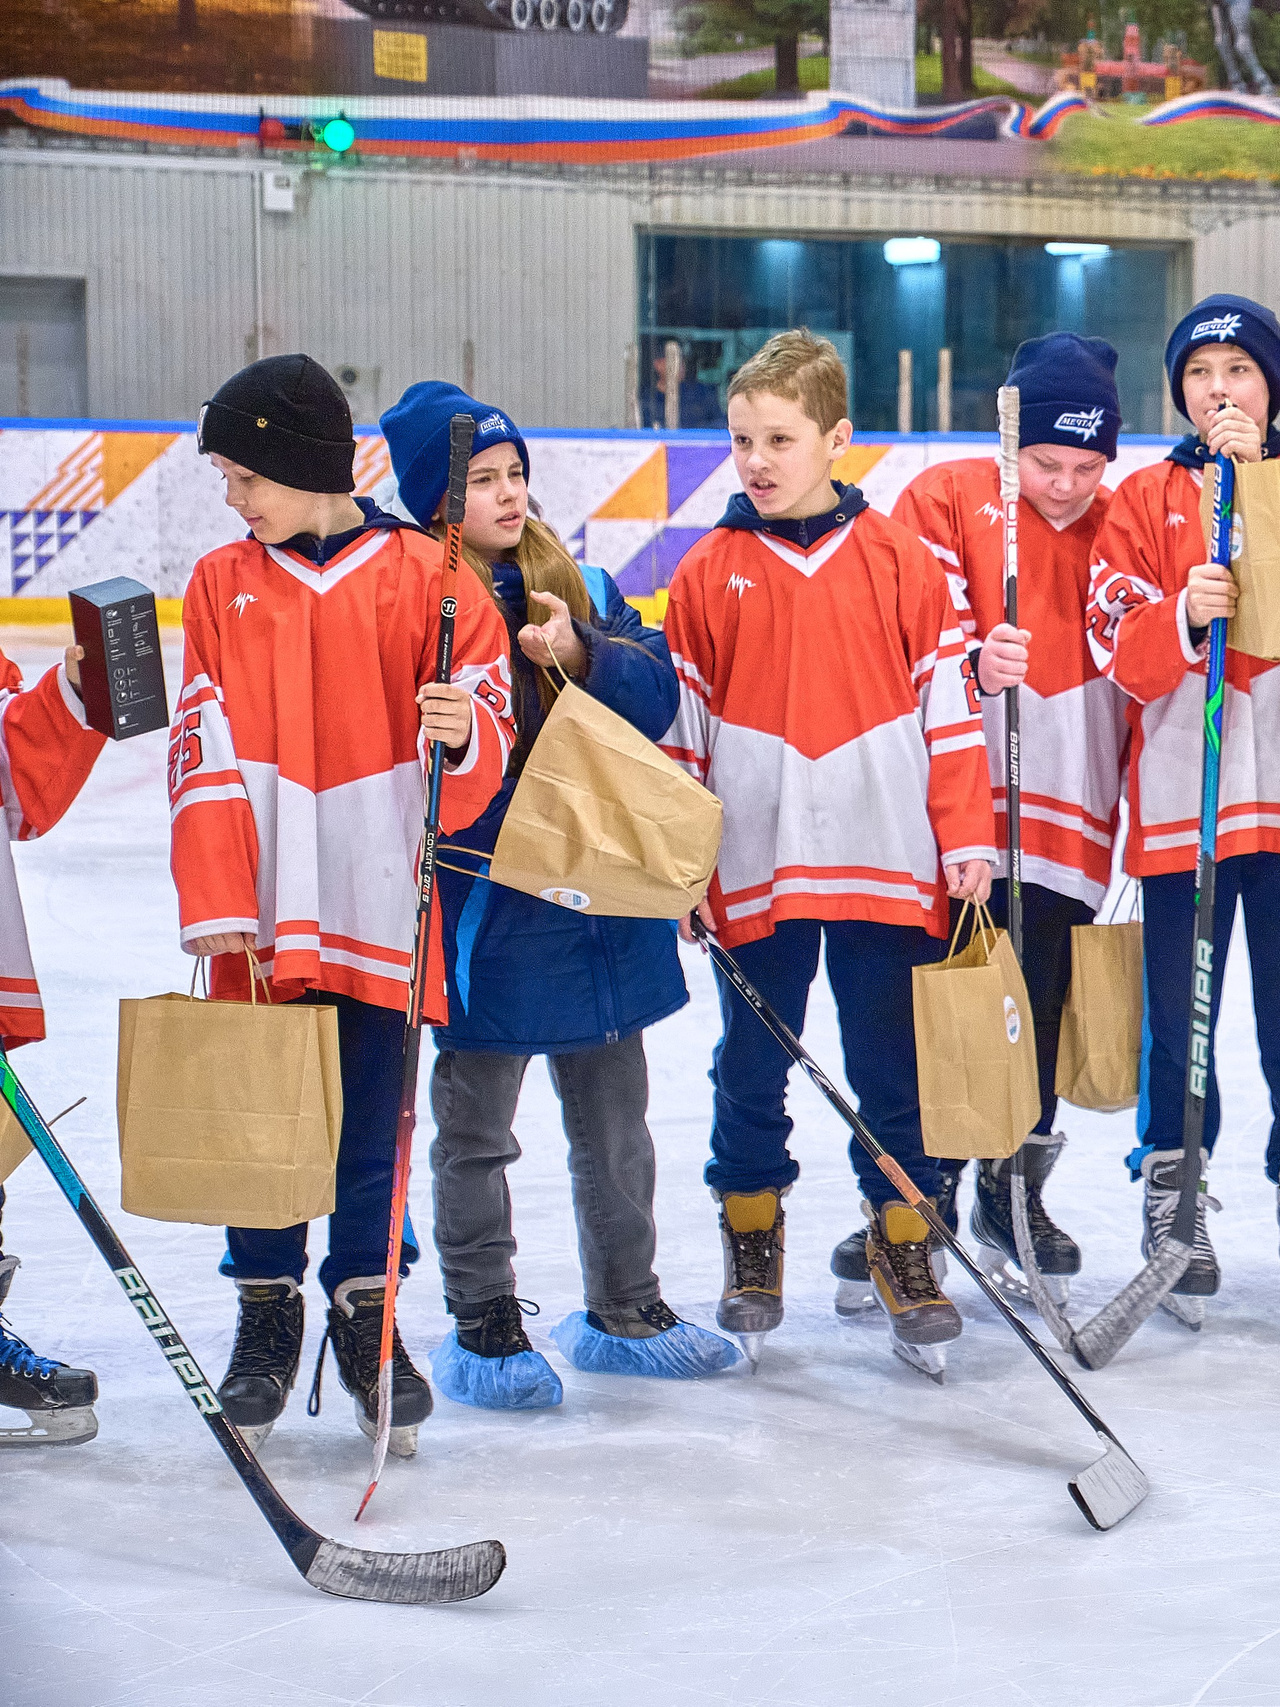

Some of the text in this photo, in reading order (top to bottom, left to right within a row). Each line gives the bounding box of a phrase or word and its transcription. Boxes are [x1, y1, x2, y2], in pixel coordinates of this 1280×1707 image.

[1060, 416, 1093, 428] МЕЧТА
[1009, 730, 1019, 787] BAUER
[425, 832, 436, 873] COVERT
[1189, 938, 1214, 1099] BAUER
[113, 1266, 224, 1415] BAUER
